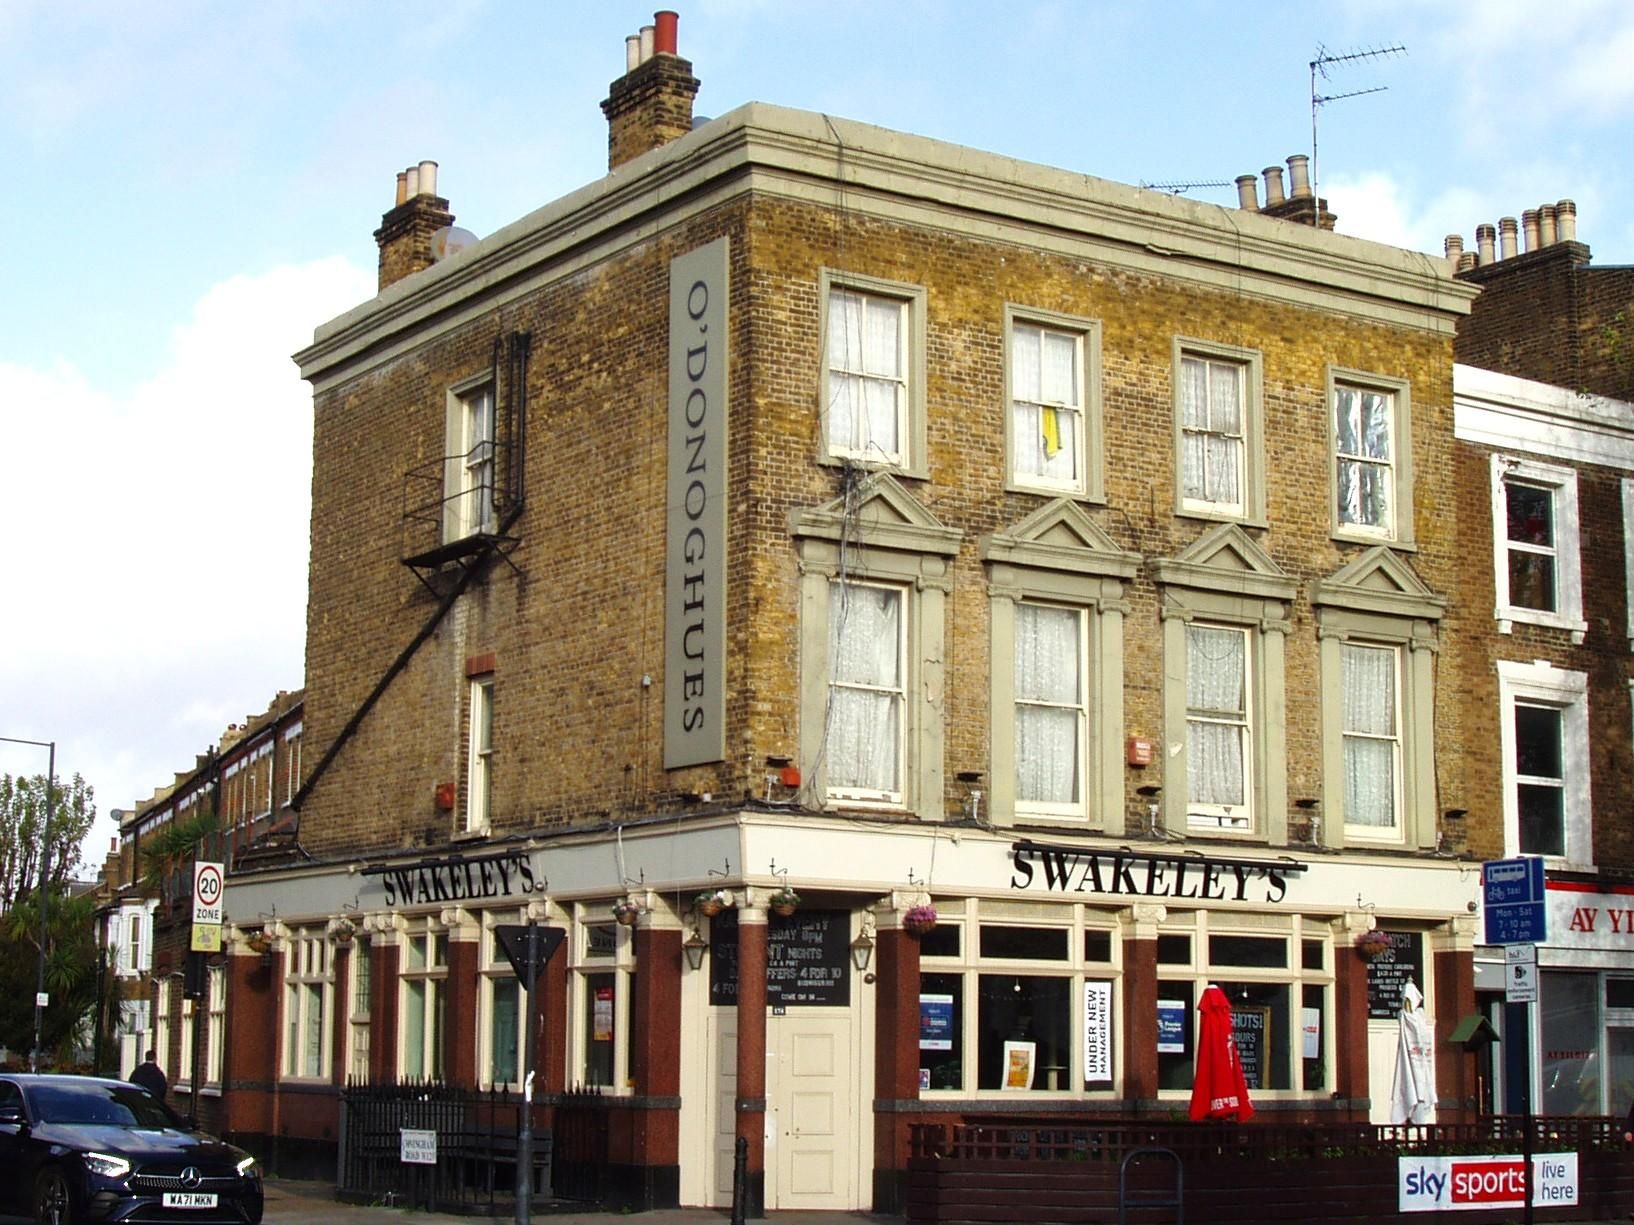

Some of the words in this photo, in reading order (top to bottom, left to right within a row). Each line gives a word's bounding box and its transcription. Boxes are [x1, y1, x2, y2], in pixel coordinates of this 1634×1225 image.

[683, 279, 710, 733] O'DONOGHUES
[201, 878, 218, 895] 20
[383, 853, 535, 906] SWAKELEY'S
[1010, 849, 1288, 904] SWAKELEY'S
[196, 908, 220, 920] ZONE
[1496, 909, 1513, 918] Mon
[1519, 906, 1533, 916] Sat
[1569, 907, 1598, 932] AY
[766, 967, 798, 980] FFERS
[1088, 989, 1098, 1021] NEW
[1088, 1026, 1098, 1073] UNDER
[1541, 1161, 1565, 1179] live
[1406, 1166, 1446, 1202] sky
[1541, 1183, 1574, 1200] here
